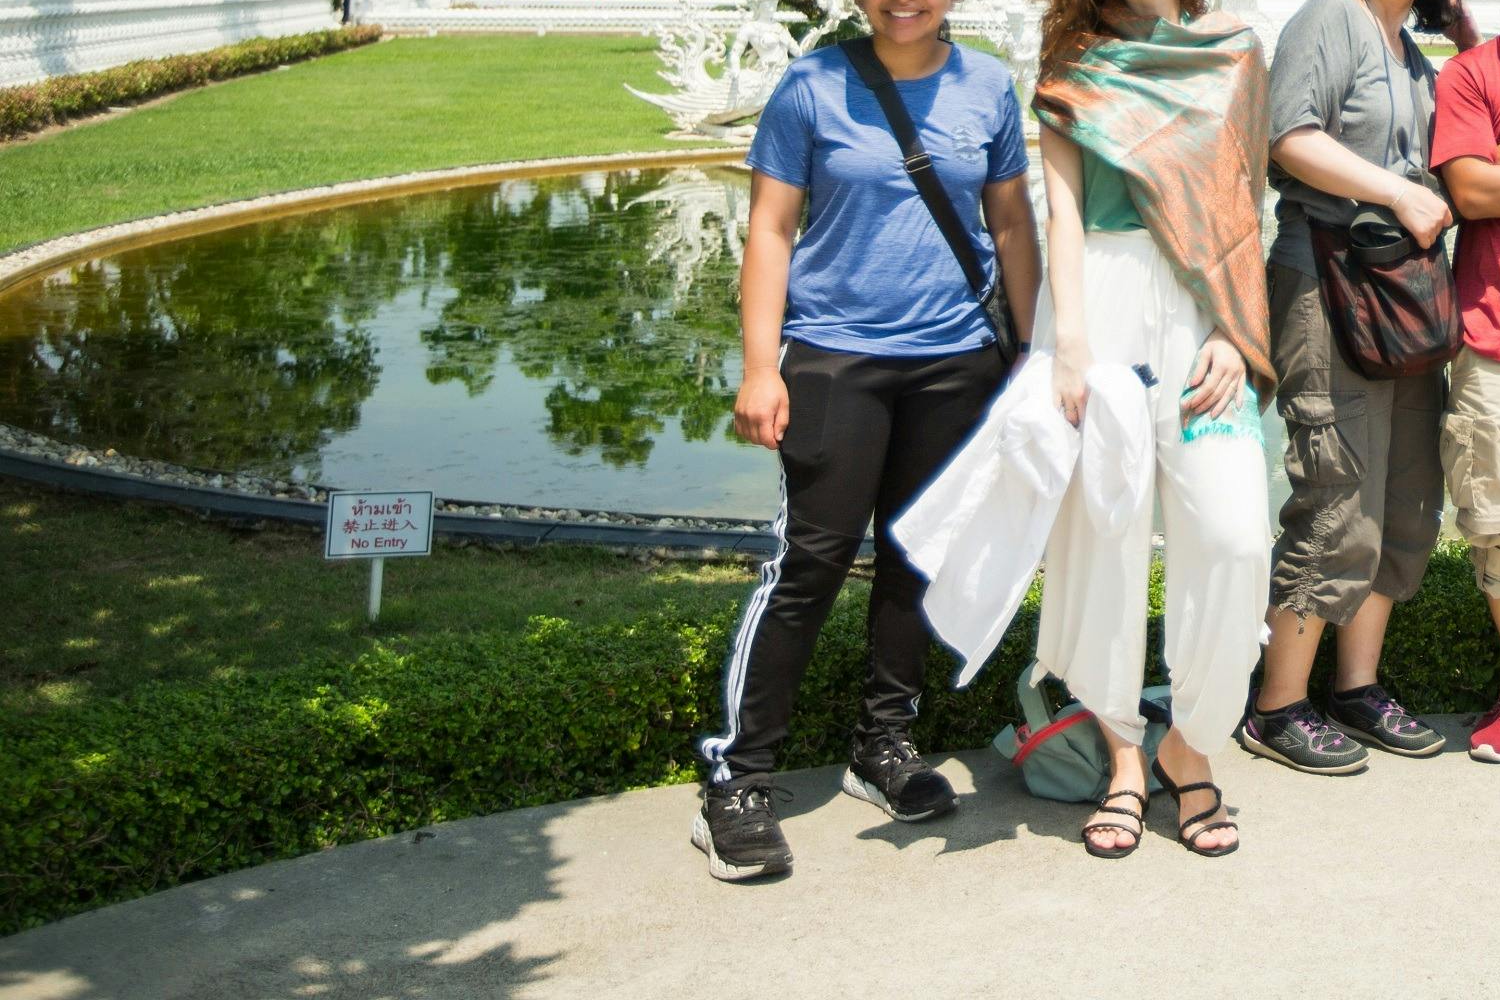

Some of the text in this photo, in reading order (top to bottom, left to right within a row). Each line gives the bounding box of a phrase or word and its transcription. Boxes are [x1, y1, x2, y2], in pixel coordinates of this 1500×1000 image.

[352, 498, 412, 516] ห้ามเข้า
[343, 518, 418, 534] 禁止进入
[351, 537, 408, 549] No Entry
